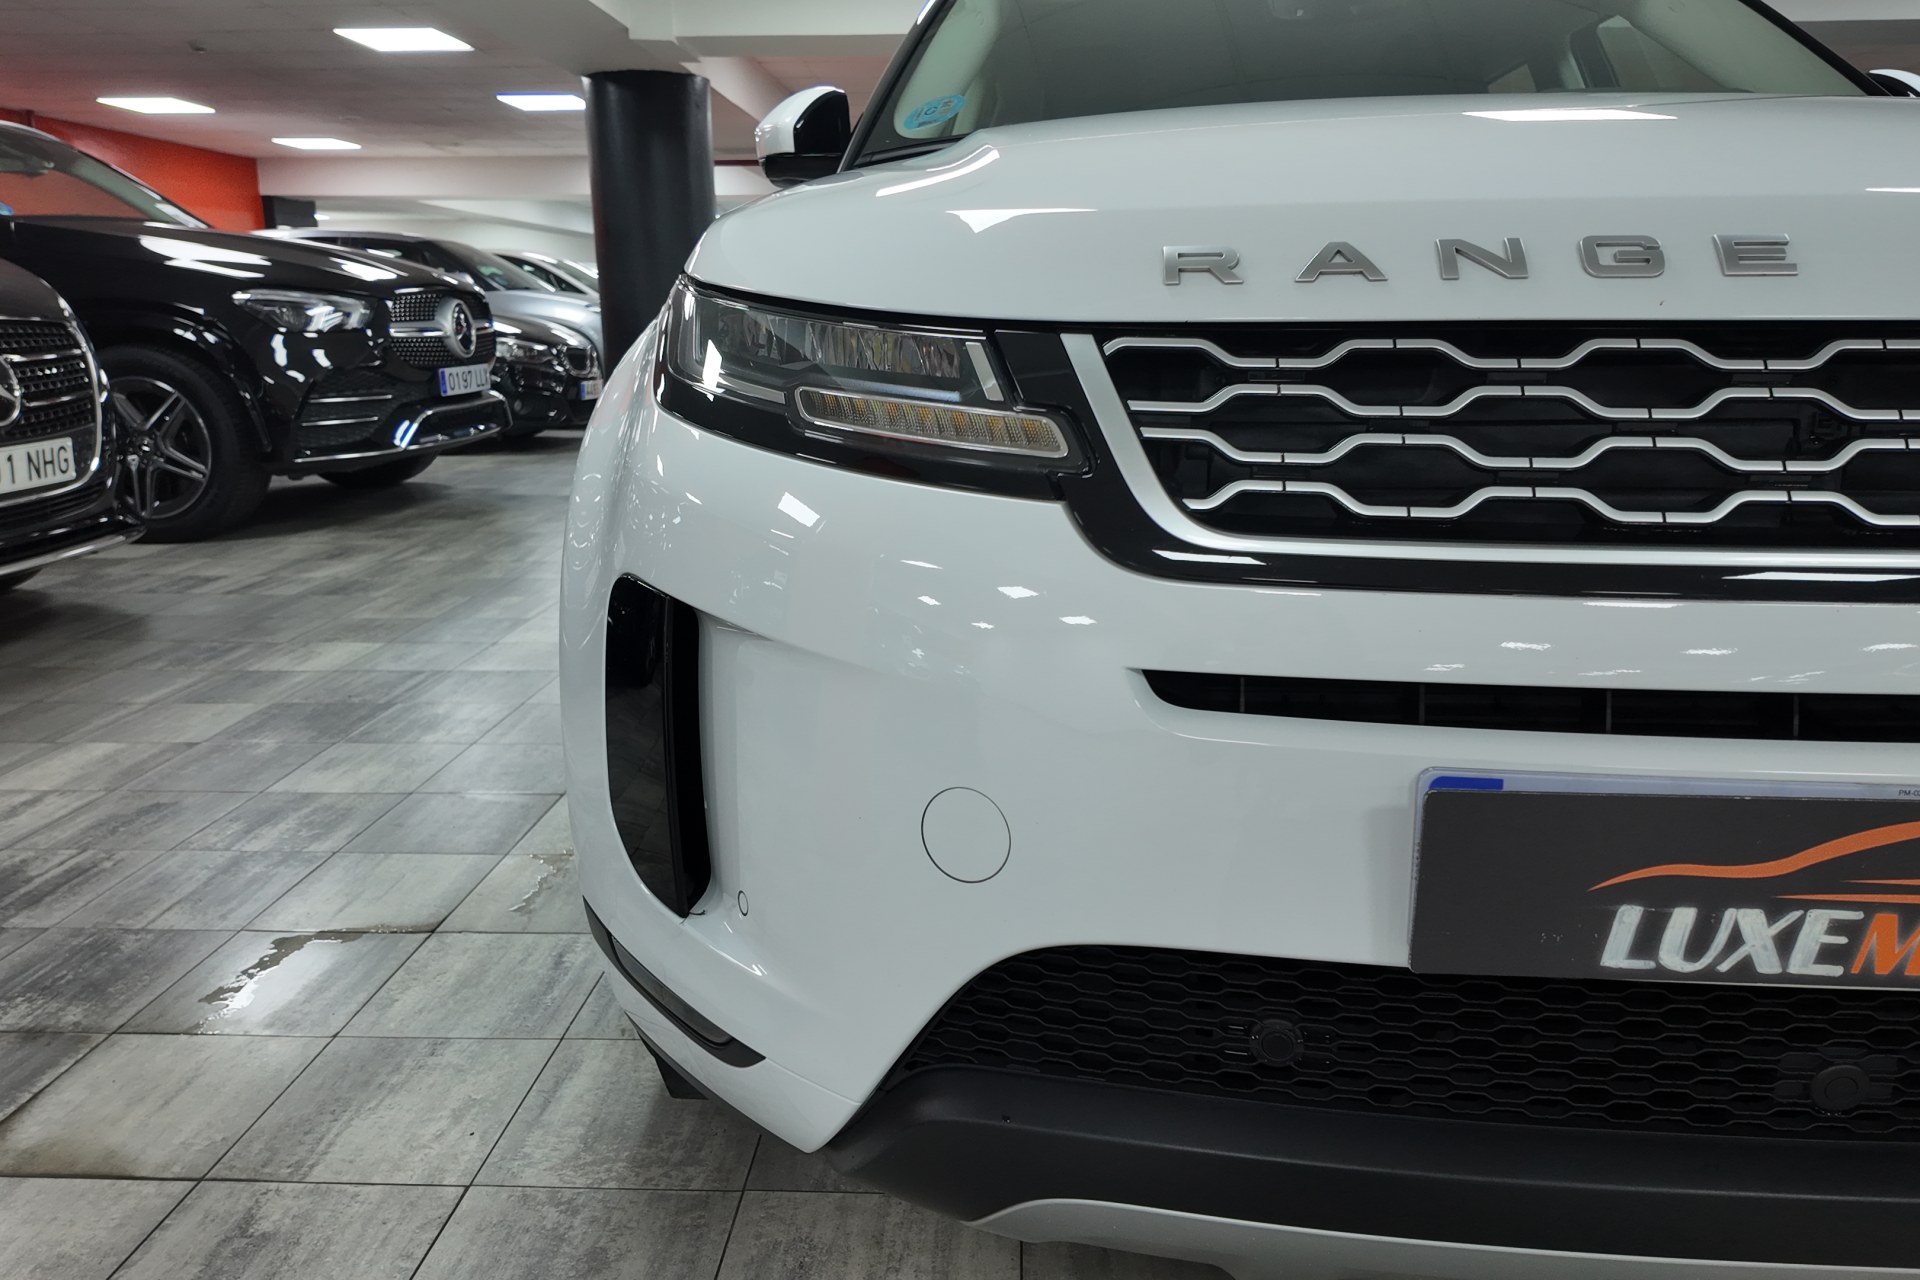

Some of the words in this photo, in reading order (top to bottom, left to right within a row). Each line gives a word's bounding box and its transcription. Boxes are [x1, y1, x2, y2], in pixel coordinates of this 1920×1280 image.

[1163, 233, 1798, 285] RANGE
[448, 370, 472, 391] 0197
[0, 454, 15, 485] 1
[27, 446, 69, 481] NHG
